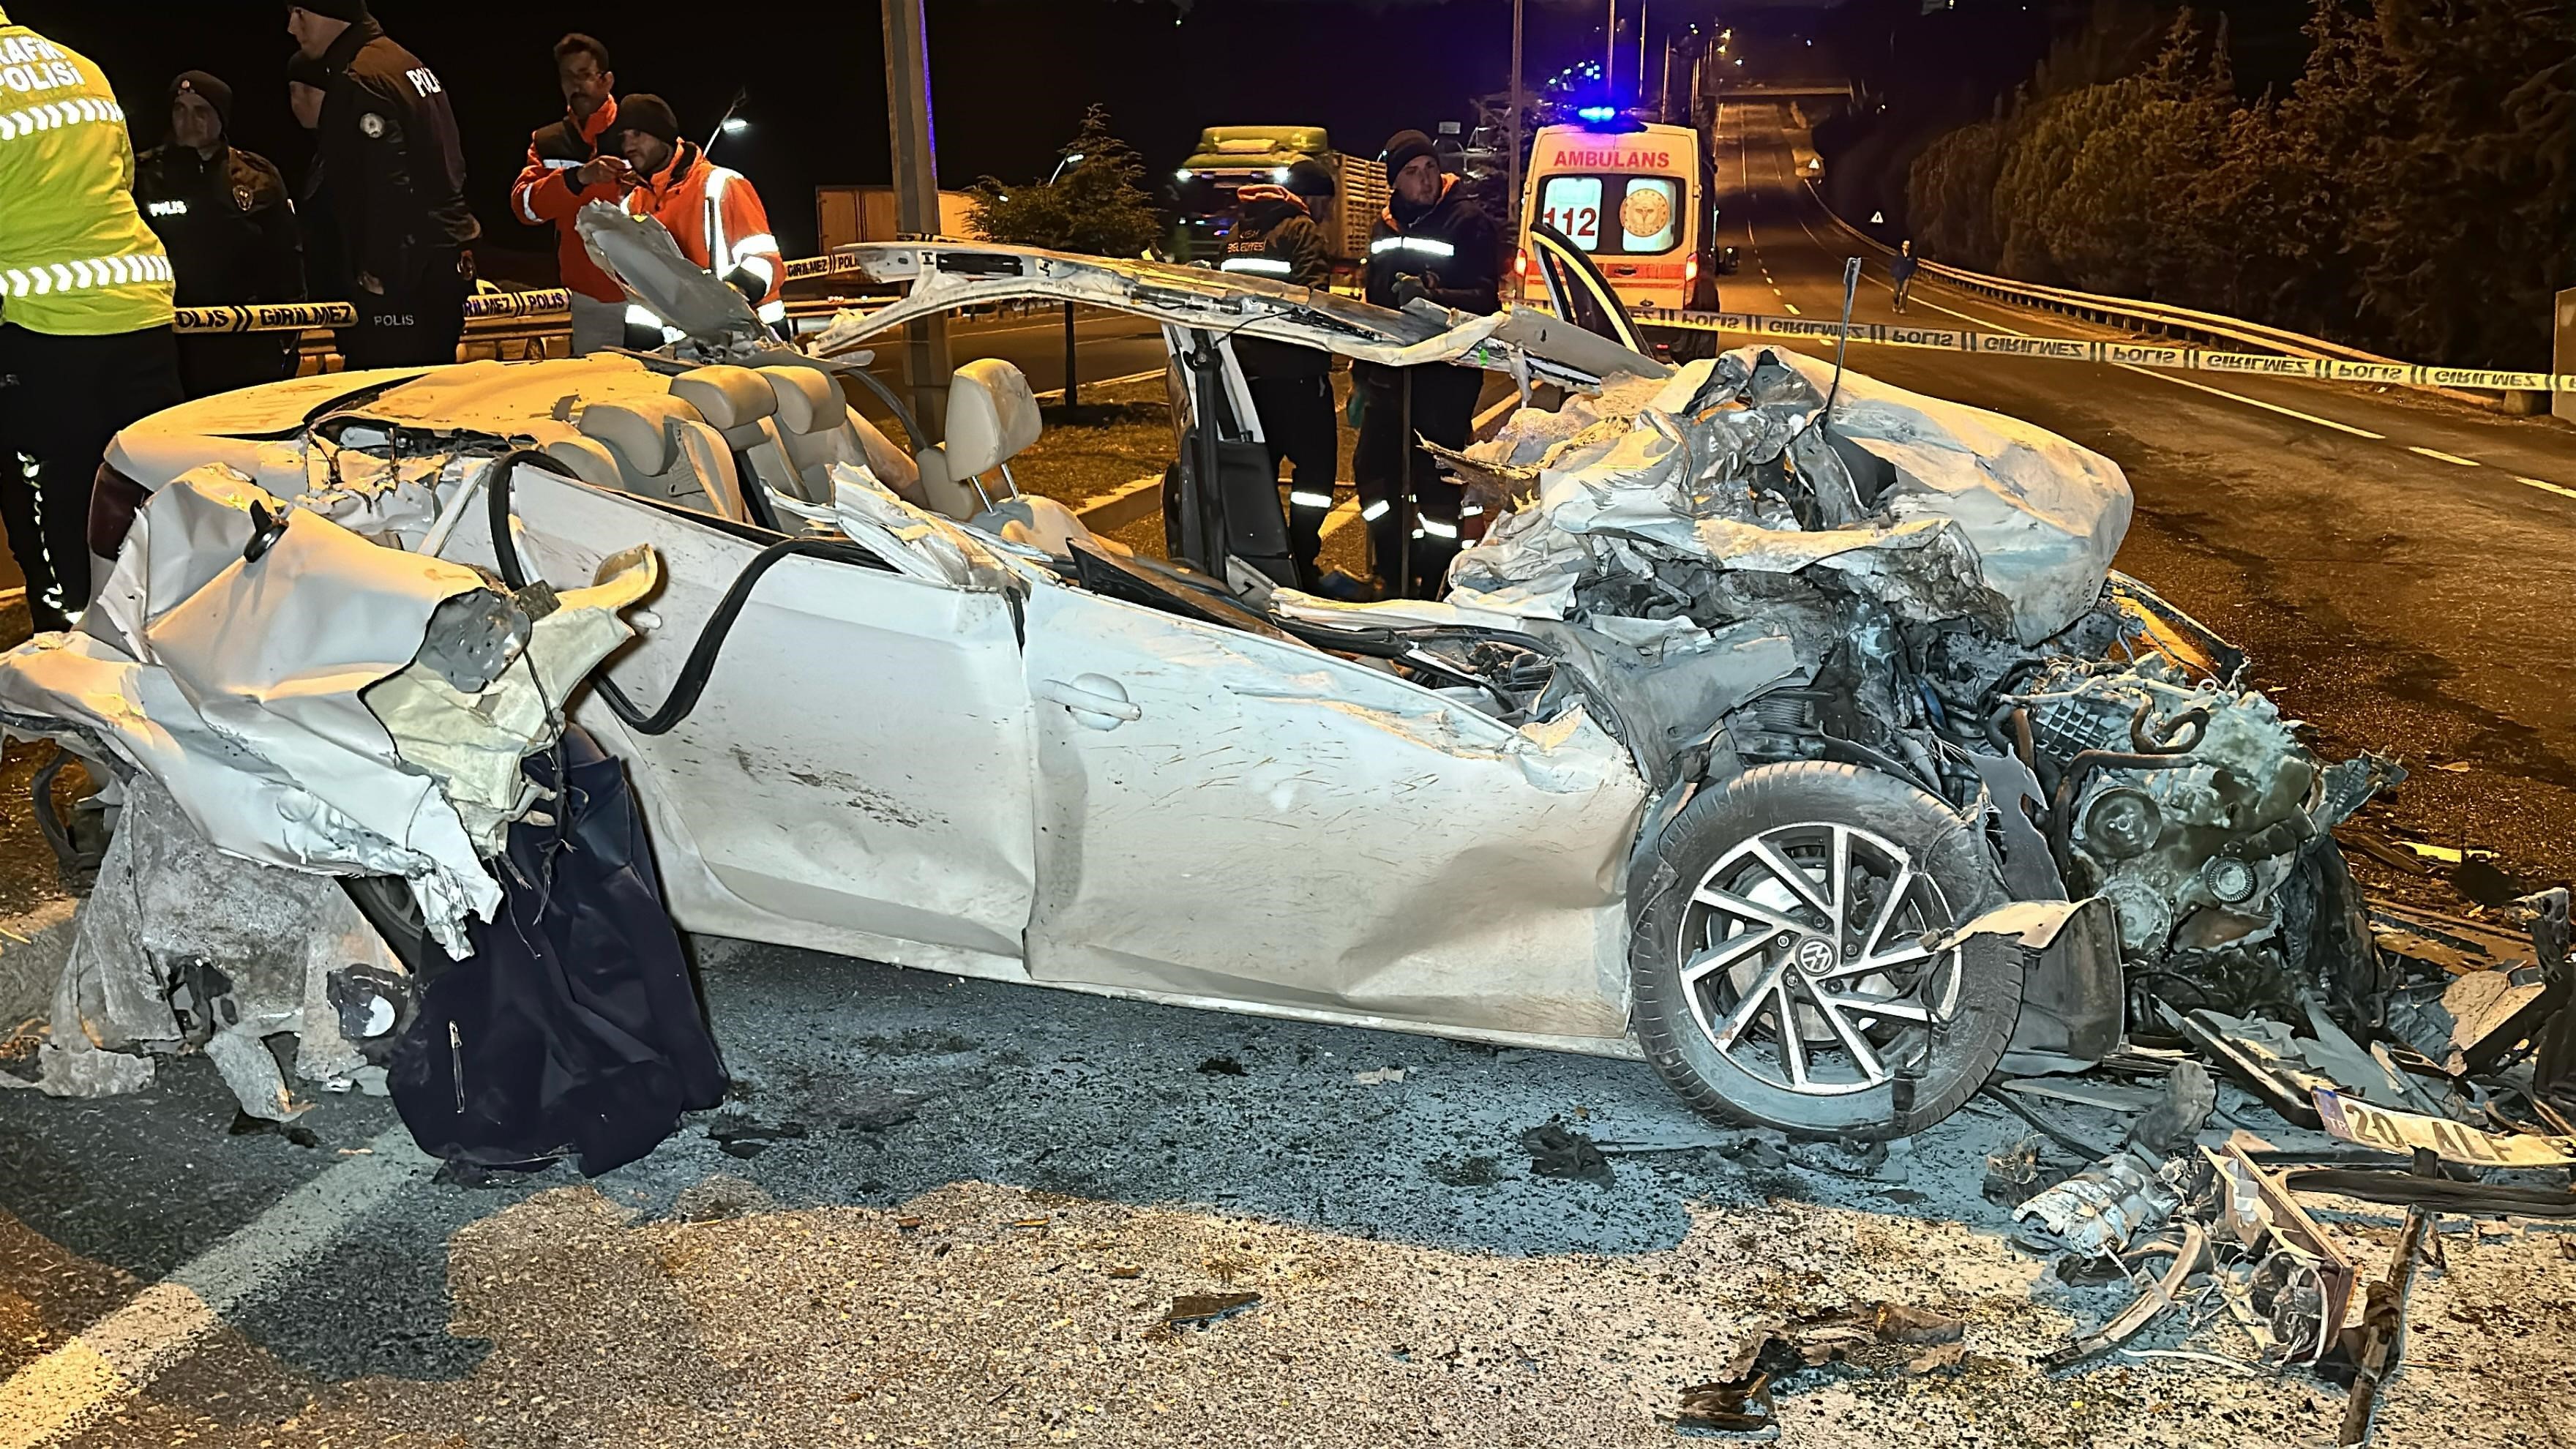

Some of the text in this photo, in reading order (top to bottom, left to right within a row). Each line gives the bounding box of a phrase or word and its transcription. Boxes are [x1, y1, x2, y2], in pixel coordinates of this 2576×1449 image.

[1554, 151, 1670, 168] AMBULANS
[1544, 207, 1597, 236] 112
[374, 315, 414, 326] POLIS
[2326, 1117, 2348, 1130] TR
[2345, 1104, 2406, 1148] 20
